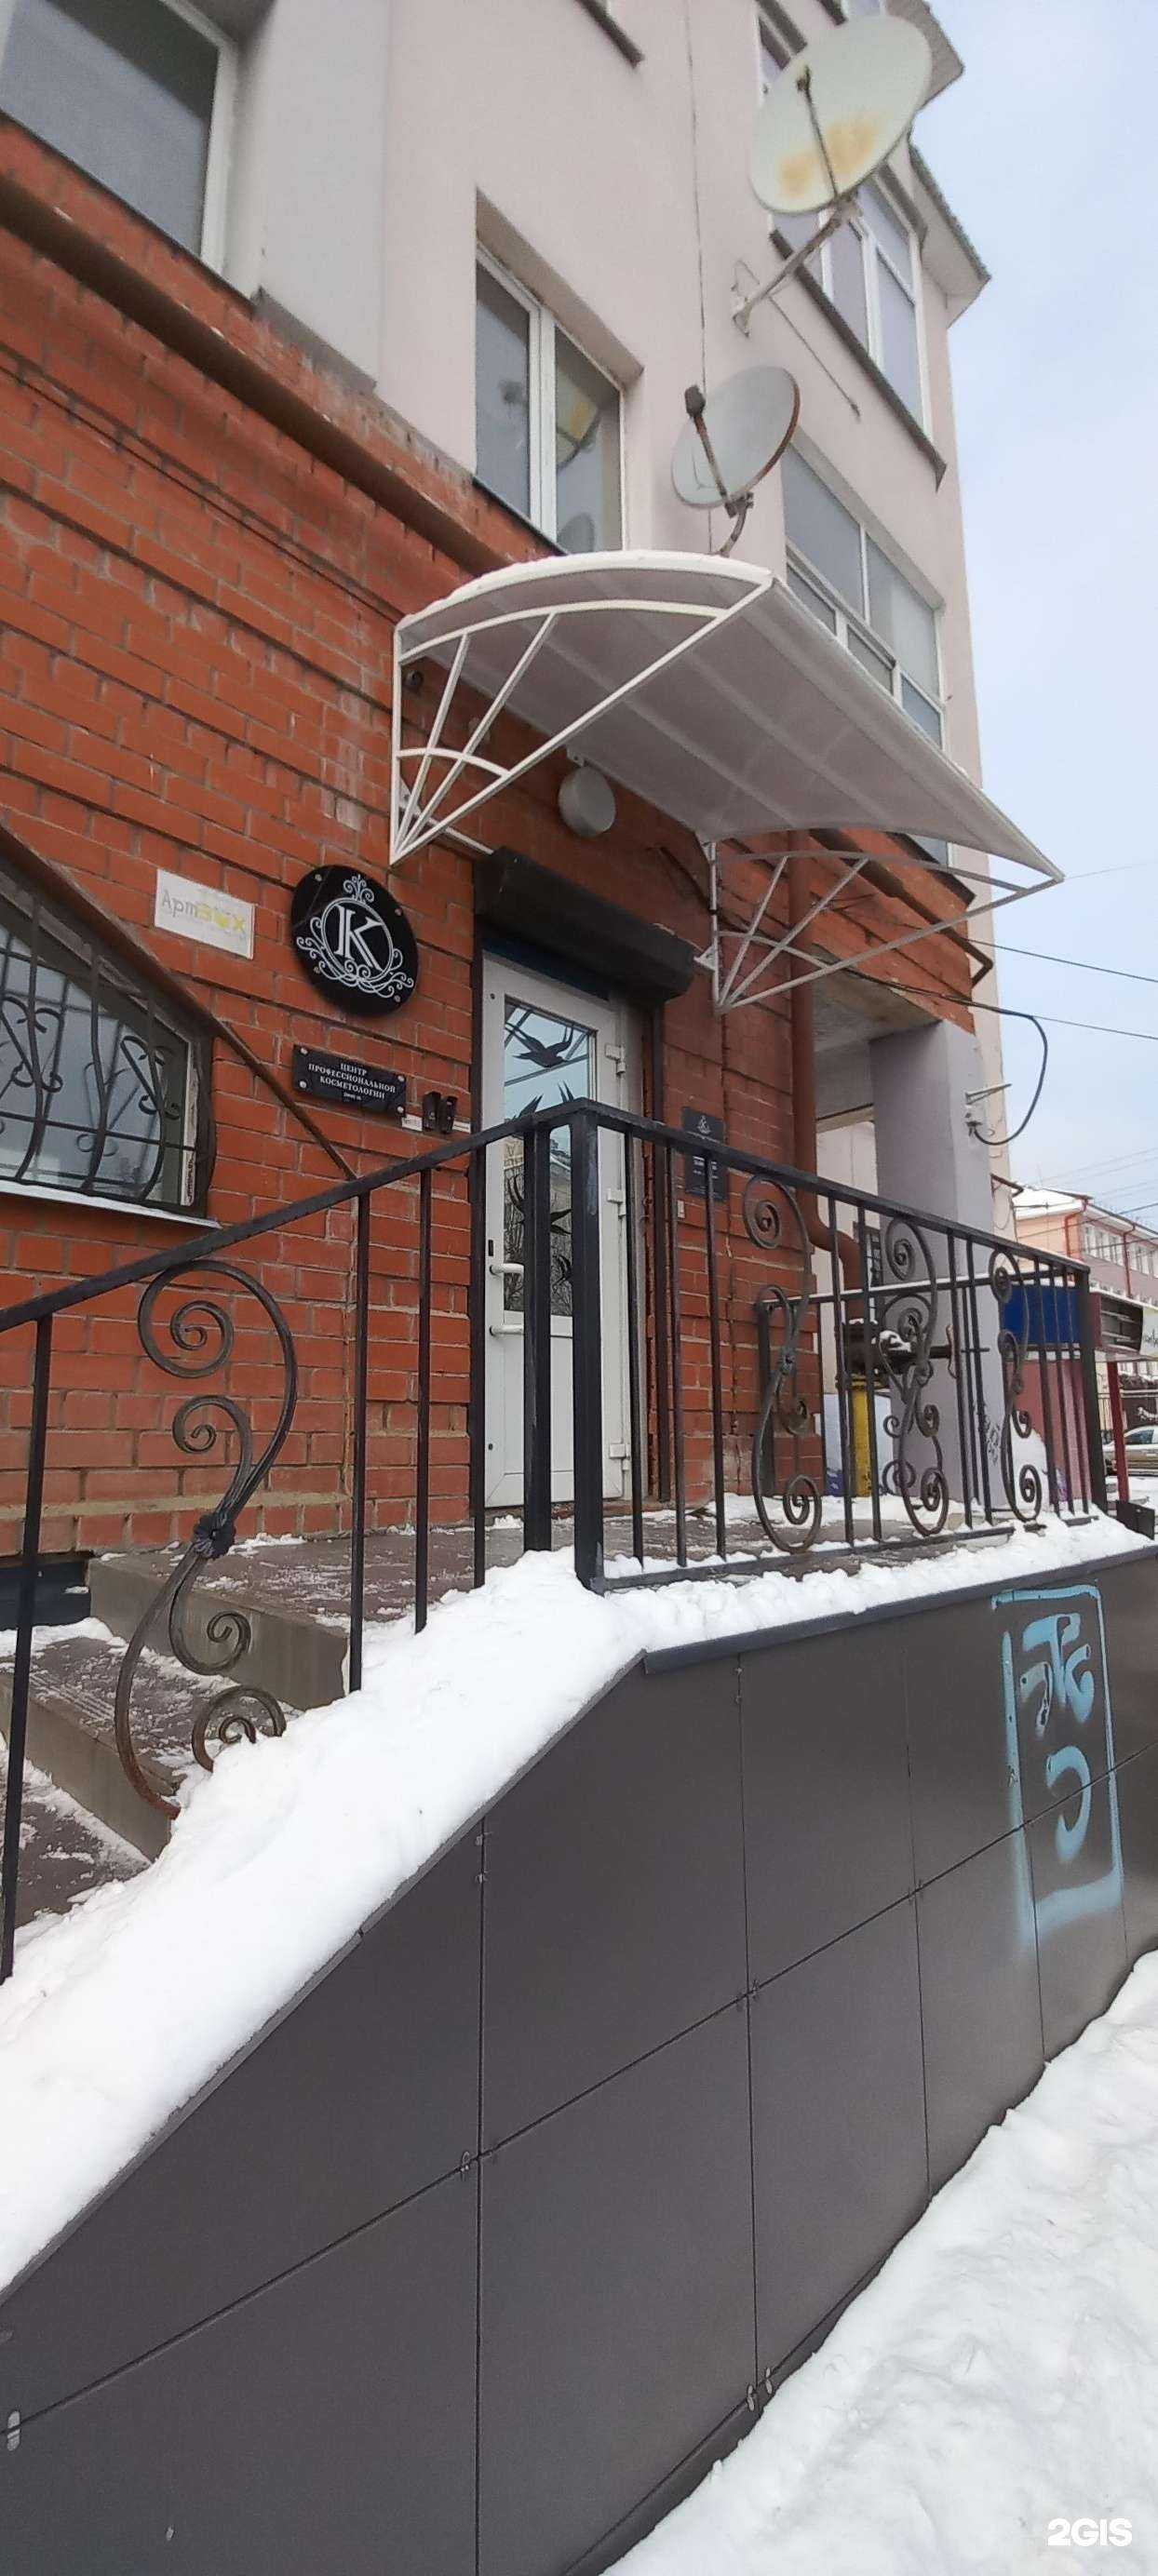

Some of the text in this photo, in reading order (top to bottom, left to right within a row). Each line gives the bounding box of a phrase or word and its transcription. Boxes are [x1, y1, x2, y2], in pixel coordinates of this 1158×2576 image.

[308, 1063, 396, 1093] ПРОФЕССИОНАЛЬНОЙ
[341, 1063, 367, 1077] ЦЕНТР
[319, 1076, 385, 1099] КОСМЕТОЛОГИИ
